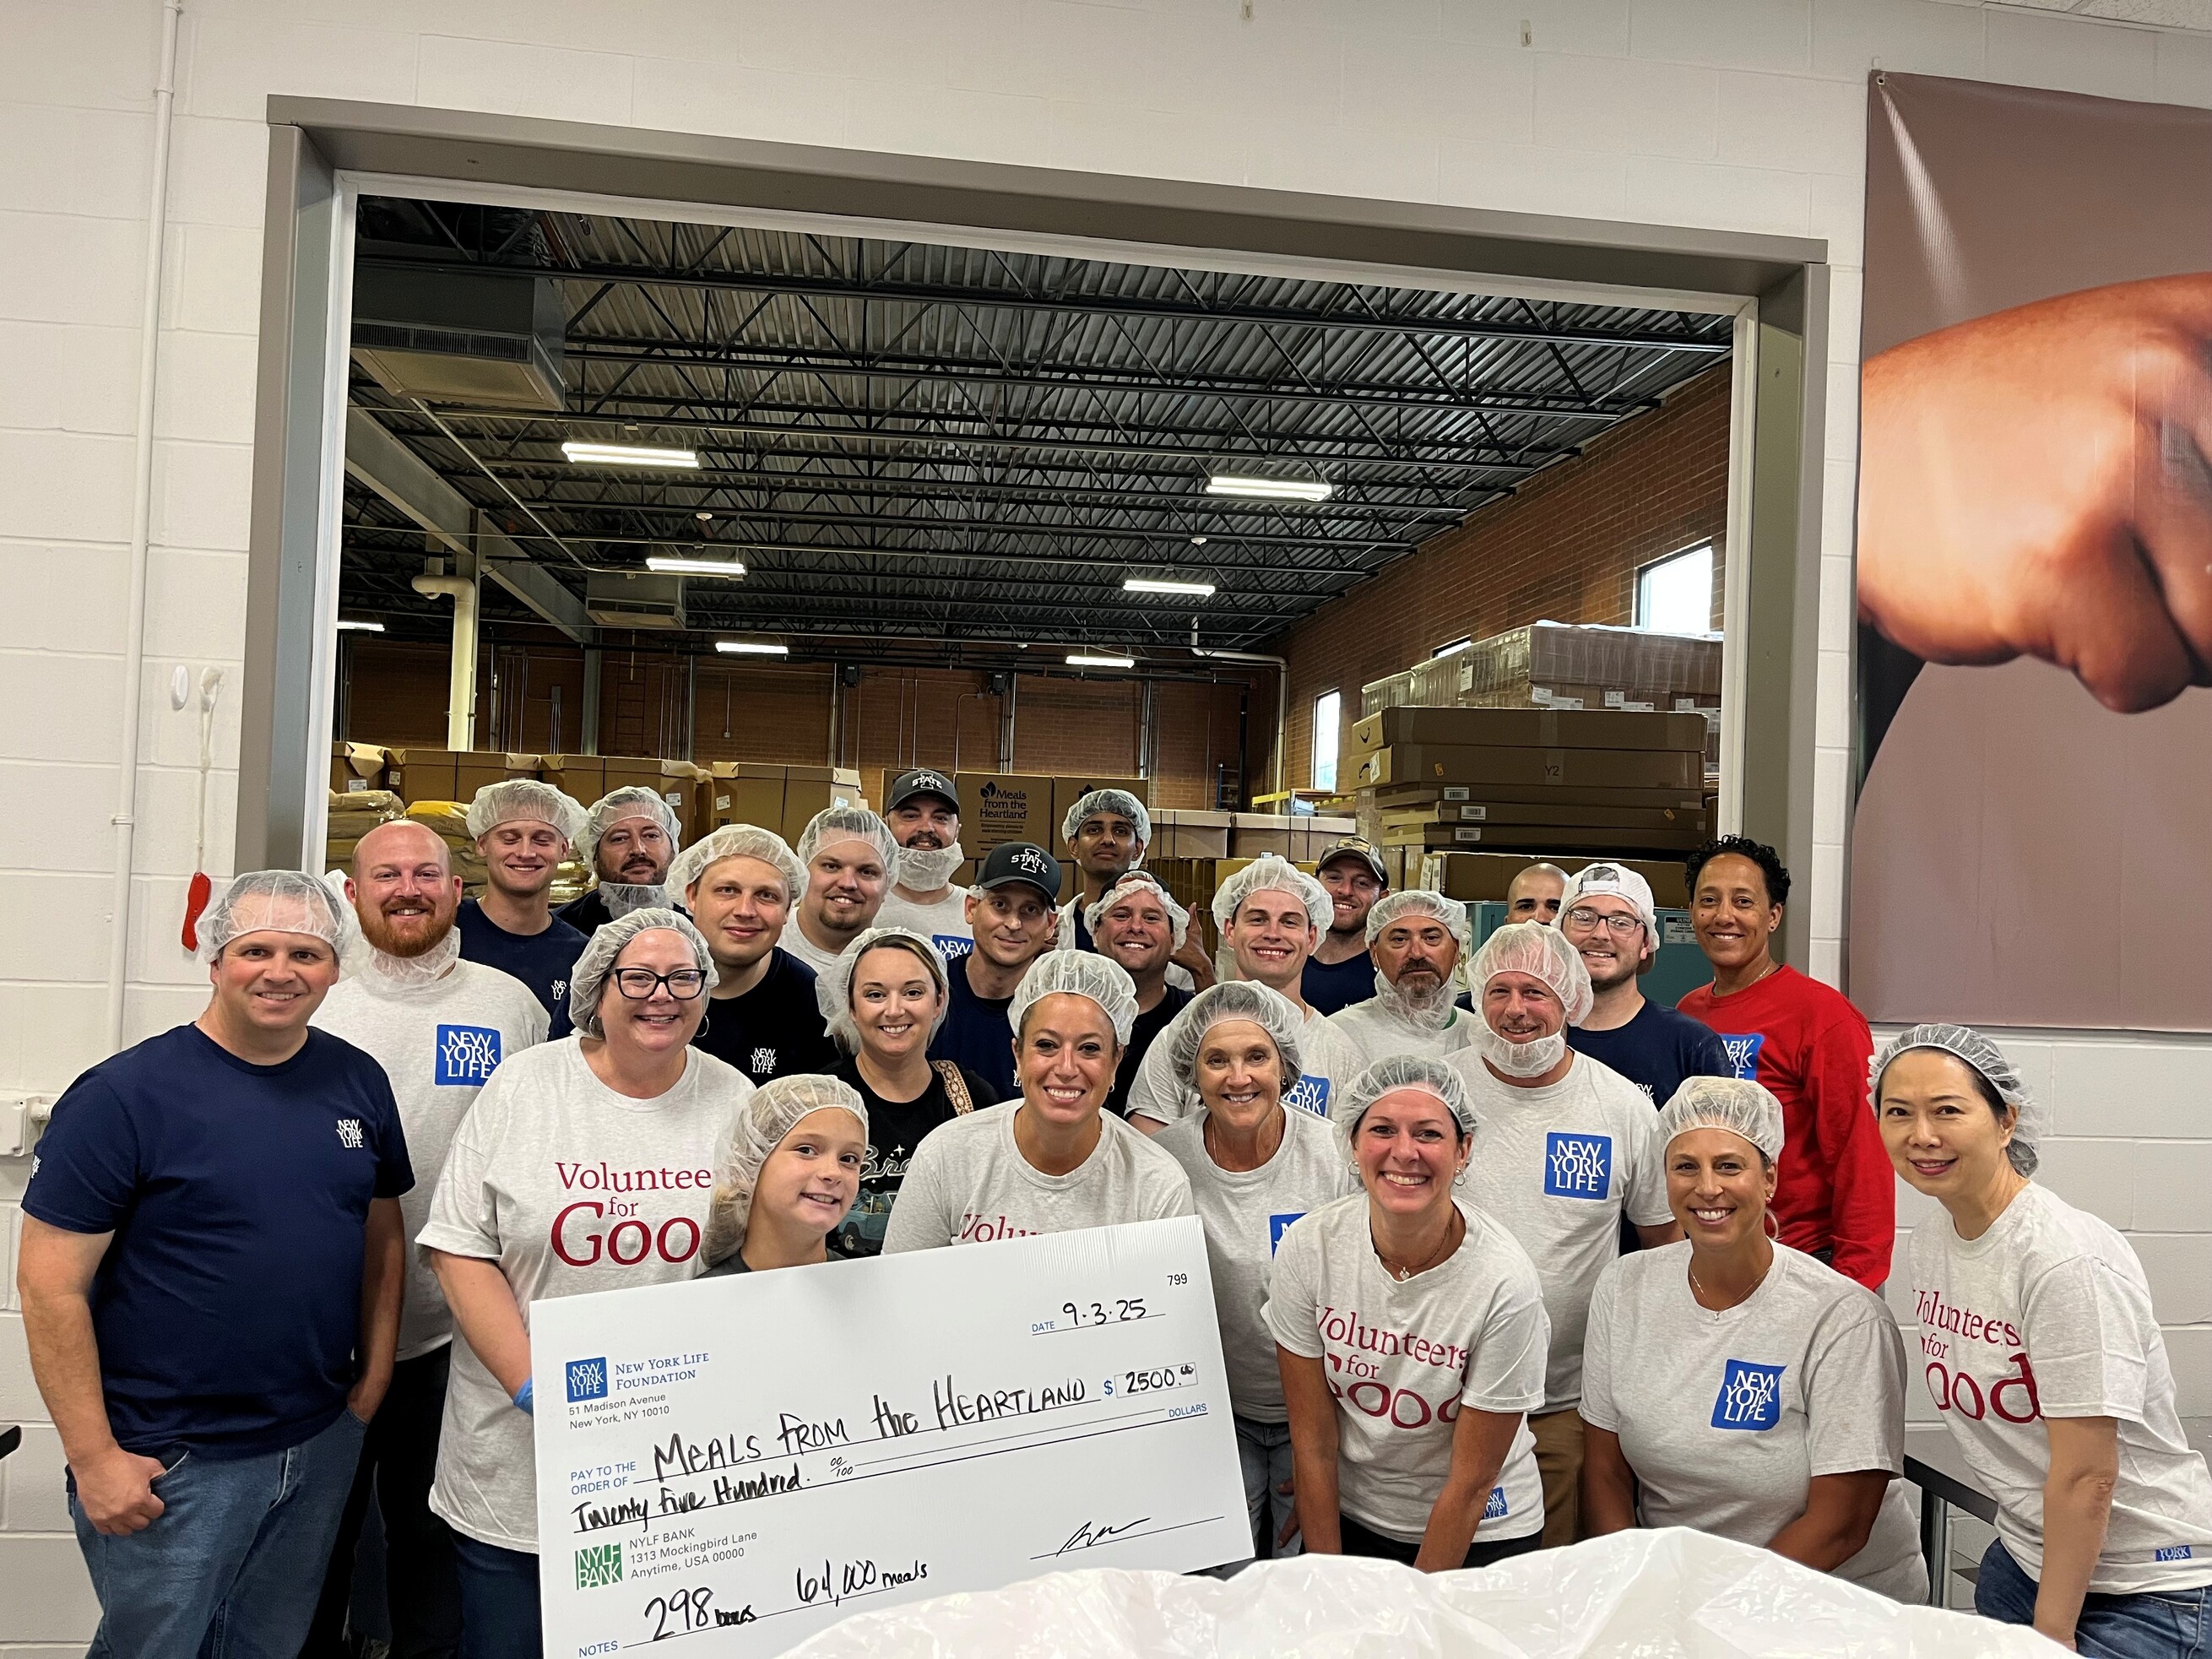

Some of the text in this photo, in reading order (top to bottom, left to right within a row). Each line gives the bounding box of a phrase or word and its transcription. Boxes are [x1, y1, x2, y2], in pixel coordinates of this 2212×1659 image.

[1545, 765, 1560, 776] Y2
[996, 789, 1027, 800] Meals
[979, 808, 1027, 819] Heartland
[984, 799, 1027, 810] from the
[1011, 854, 1048, 874] STATE
[939, 940, 971, 955] NEW
[447, 1031, 491, 1047] NEW
[439, 1044, 497, 1065] YORK
[751, 1054, 777, 1066] YORK
[754, 1048, 776, 1057] NEW
[447, 1060, 491, 1079] LIFE
[752, 1064, 773, 1074] LIFE
[336, 1128, 363, 1140] YORK
[337, 1119, 360, 1130] NEW
[343, 1138, 363, 1148] LIFE
[1556, 1140, 1602, 1158] NEW
[1548, 1154, 1606, 1177] YORK
[554, 1162, 713, 1193] Voluntee
[1555, 1171, 1598, 1192] LIFE
[607, 1195, 639, 1217] for
[550, 1201, 702, 1267] Goo
[1167, 1273, 1188, 1287] 799
[1031, 1320, 1055, 1333] DATE
[1926, 1333, 1949, 1359] for
[571, 1362, 600, 1378] NEW
[1346, 1354, 1380, 1380] for
[568, 1373, 605, 1388] YORK
[1103, 1380, 1114, 1396] $
[1733, 1369, 1781, 1391] NEW
[1921, 1336, 2046, 1424] ood
[573, 1383, 601, 1397] LIFE
[1725, 1385, 1774, 1406] YORK
[568, 1394, 666, 1416] 51 Madison Avenue
[870, 1395, 919, 1439] the
[933, 1374, 1086, 1432] HEARTLAND
[1168, 1403, 1207, 1418] DOLLARS
[1723, 1401, 1766, 1422] LIFE
[569, 1405, 670, 1430] New York, NY 10010
[571, 1461, 637, 1482] PAY TO THE
[571, 1477, 628, 1496] ORDER OF
[629, 1527, 696, 1549] NYLF BANK
[631, 1531, 757, 1564] 1313 Mockingbird Lane
[576, 1543, 621, 1569] NYLF
[631, 1548, 745, 1580] Anytime, USA 00000
[577, 1563, 622, 1589] BANK
[644, 1586, 714, 1641] 298
[796, 1559, 876, 1608] 64,000
[881, 1559, 928, 1588] meals
[578, 1640, 618, 1658] NOTES
